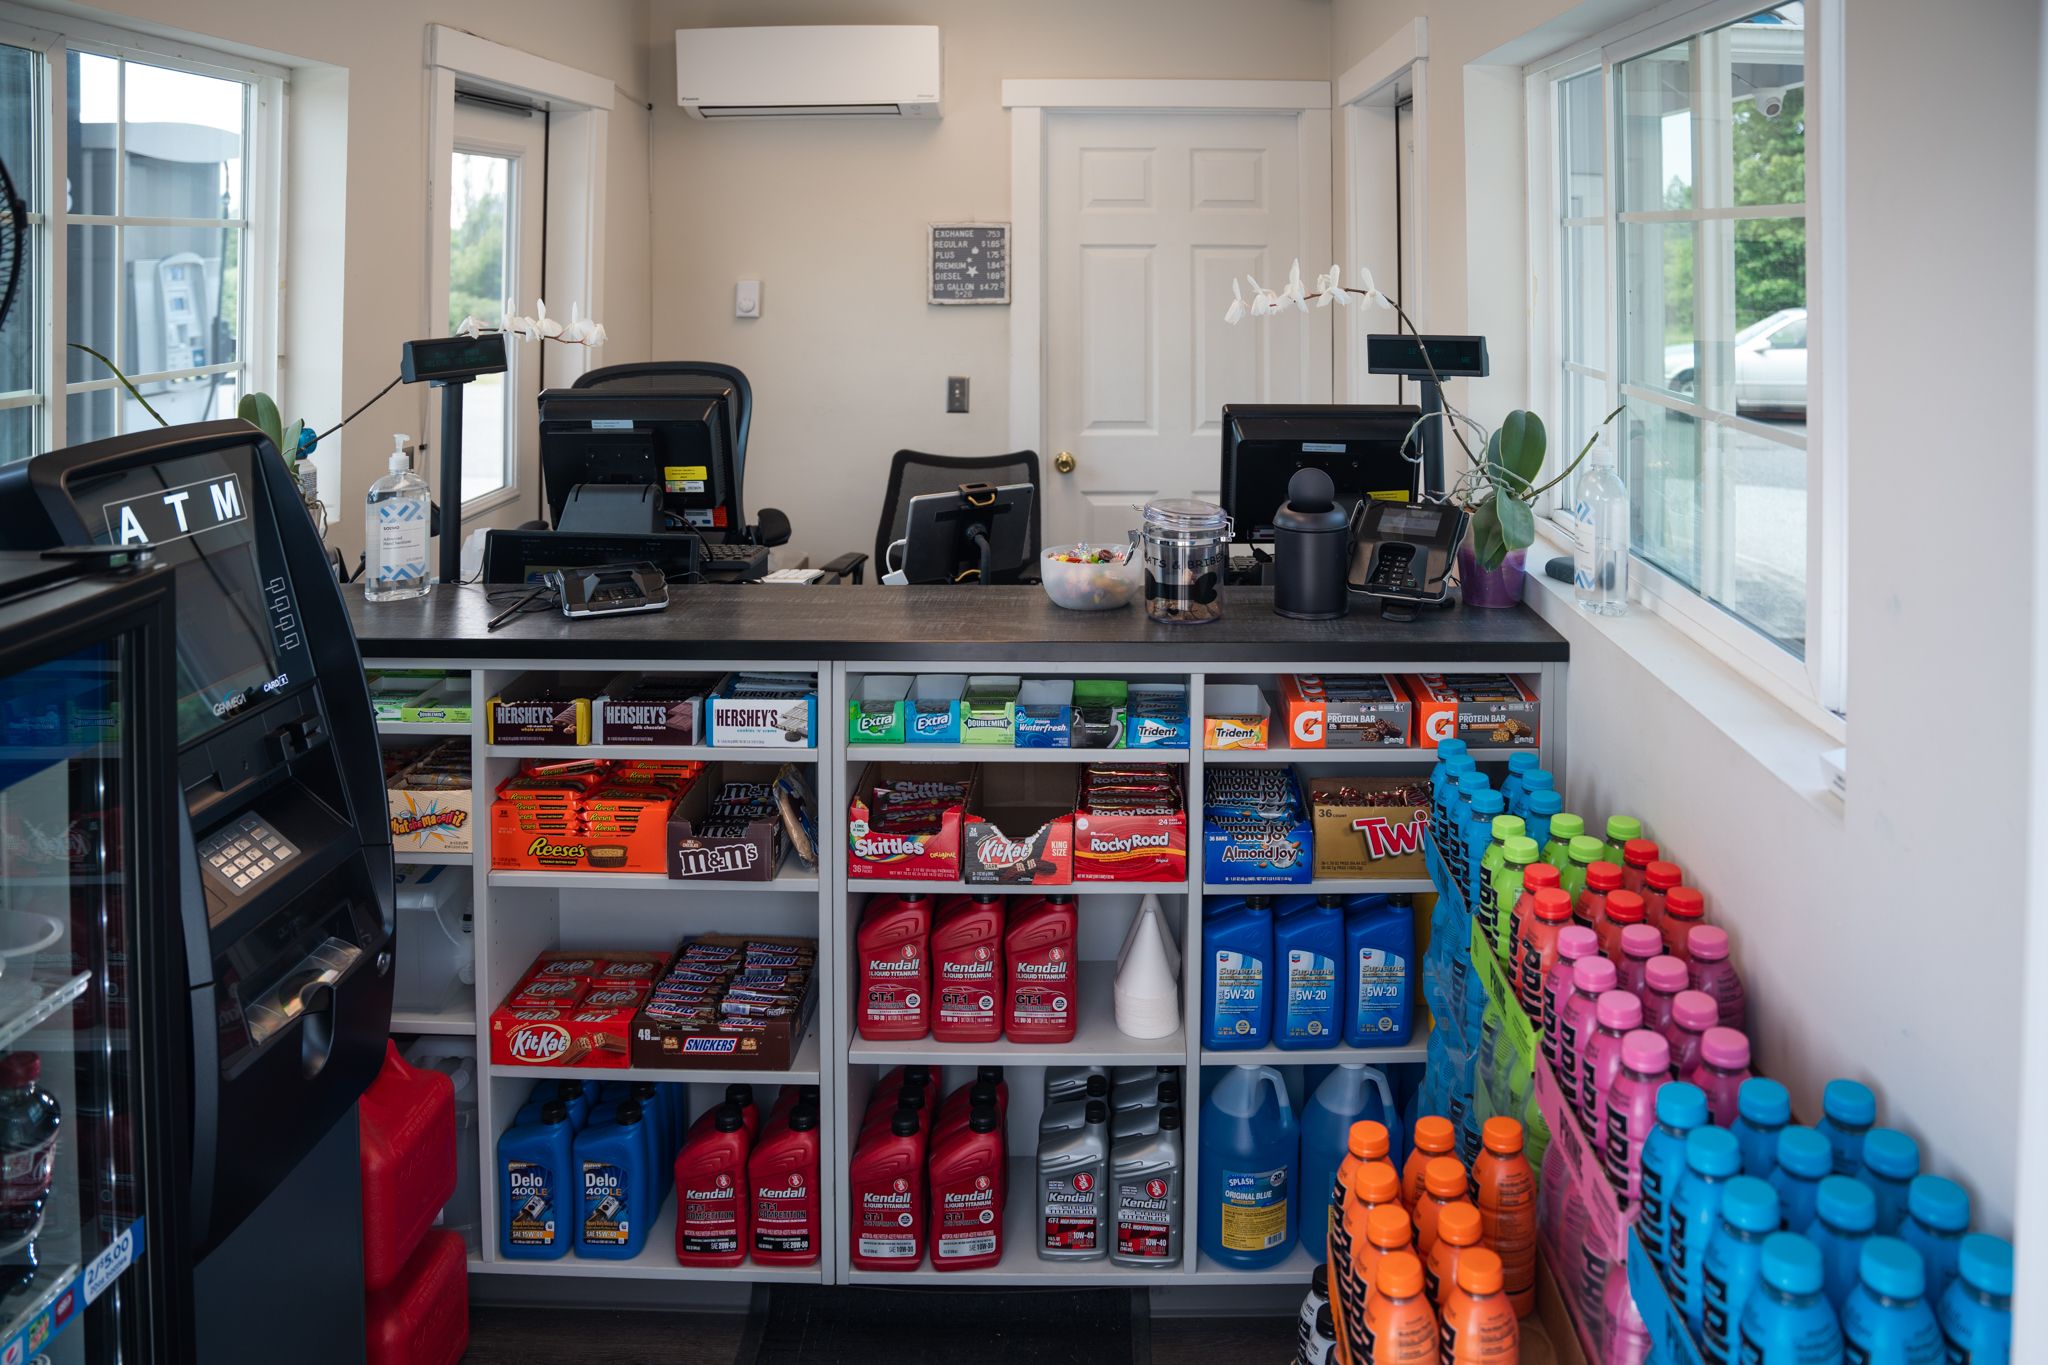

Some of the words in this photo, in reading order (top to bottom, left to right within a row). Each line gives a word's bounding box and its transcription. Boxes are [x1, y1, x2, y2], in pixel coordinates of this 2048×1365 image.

[935, 230, 974, 238] EXCHANGE
[935, 262, 967, 270] PREMIUM
[947, 283, 975, 291] GALLON
[263, 679, 279, 693] CARD
[497, 706, 554, 724] HERSHEY'S
[606, 706, 667, 724] HERSHEY'S
[716, 709, 778, 727] HERSHEY'S
[1327, 715, 1359, 723] PROTEIN
[1360, 715, 1376, 723] BAR
[1459, 715, 1490, 723] PROTEIN
[1491, 715, 1506, 723] BAR
[862, 714, 893, 730] Extra
[918, 713, 949, 730] Extra
[967, 718, 1009, 728] DOUBLEMINT
[1019, 723, 1067, 732] Winterfresh
[1138, 726, 1177, 737] Trident
[1216, 728, 1254, 739] Trident
[1318, 808, 1333, 818] 36
[1158, 818, 1168, 826] 24
[1352, 810, 1429, 859] Twi
[528, 837, 587, 858] Reese's
[855, 837, 925, 857] Skittles
[1051, 841, 1068, 849] KING
[1090, 837, 1132, 852] Rocky
[1131, 832, 1169, 847] Road
[1052, 849, 1067, 857] SIZE
[1222, 845, 1274, 863] Almond
[1273, 846, 1297, 862] Joy
[853, 865, 862, 873] 36
[870, 959, 920, 971] Kendall
[943, 961, 993, 973] Kendall
[1017, 962, 1067, 974] Kendall
[869, 992, 895, 1002] GT-1
[1224, 989, 1255, 1000] 5W-20
[1296, 990, 1327, 1001] 5W-20
[1368, 986, 1398, 997] 5W-20
[942, 994, 968, 1004] GT-1
[1016, 994, 1042, 1005] GT-1
[638, 1029, 651, 1041] 48
[685, 1039, 735, 1052] SNICKERS
[511, 1173, 543, 1187] Delo
[585, 1173, 618, 1187] Delo
[1228, 1178, 1254, 1187] SPLASH
[686, 1187, 734, 1199] Kendall
[758, 1187, 806, 1199] Kendall
[864, 1193, 911, 1203] Kendall
[945, 1189, 993, 1203] Kendall
[1048, 1192, 1094, 1203] Kendall
[1225, 1189, 1256, 1200] ORIGINAL
[1256, 1190, 1273, 1200] BLUE
[965, 1200, 992, 1208] TITANIUM
[1121, 1198, 1167, 1210] Kendall
[686, 1211, 734, 1220] COMPETITION
[758, 1210, 806, 1219] COMPETITION
[1073, 1231, 1095, 1239] 10W-40
[1145, 1238, 1167, 1247] 10W-40
[87, 1236, 130, 1286] 2/$5.00
